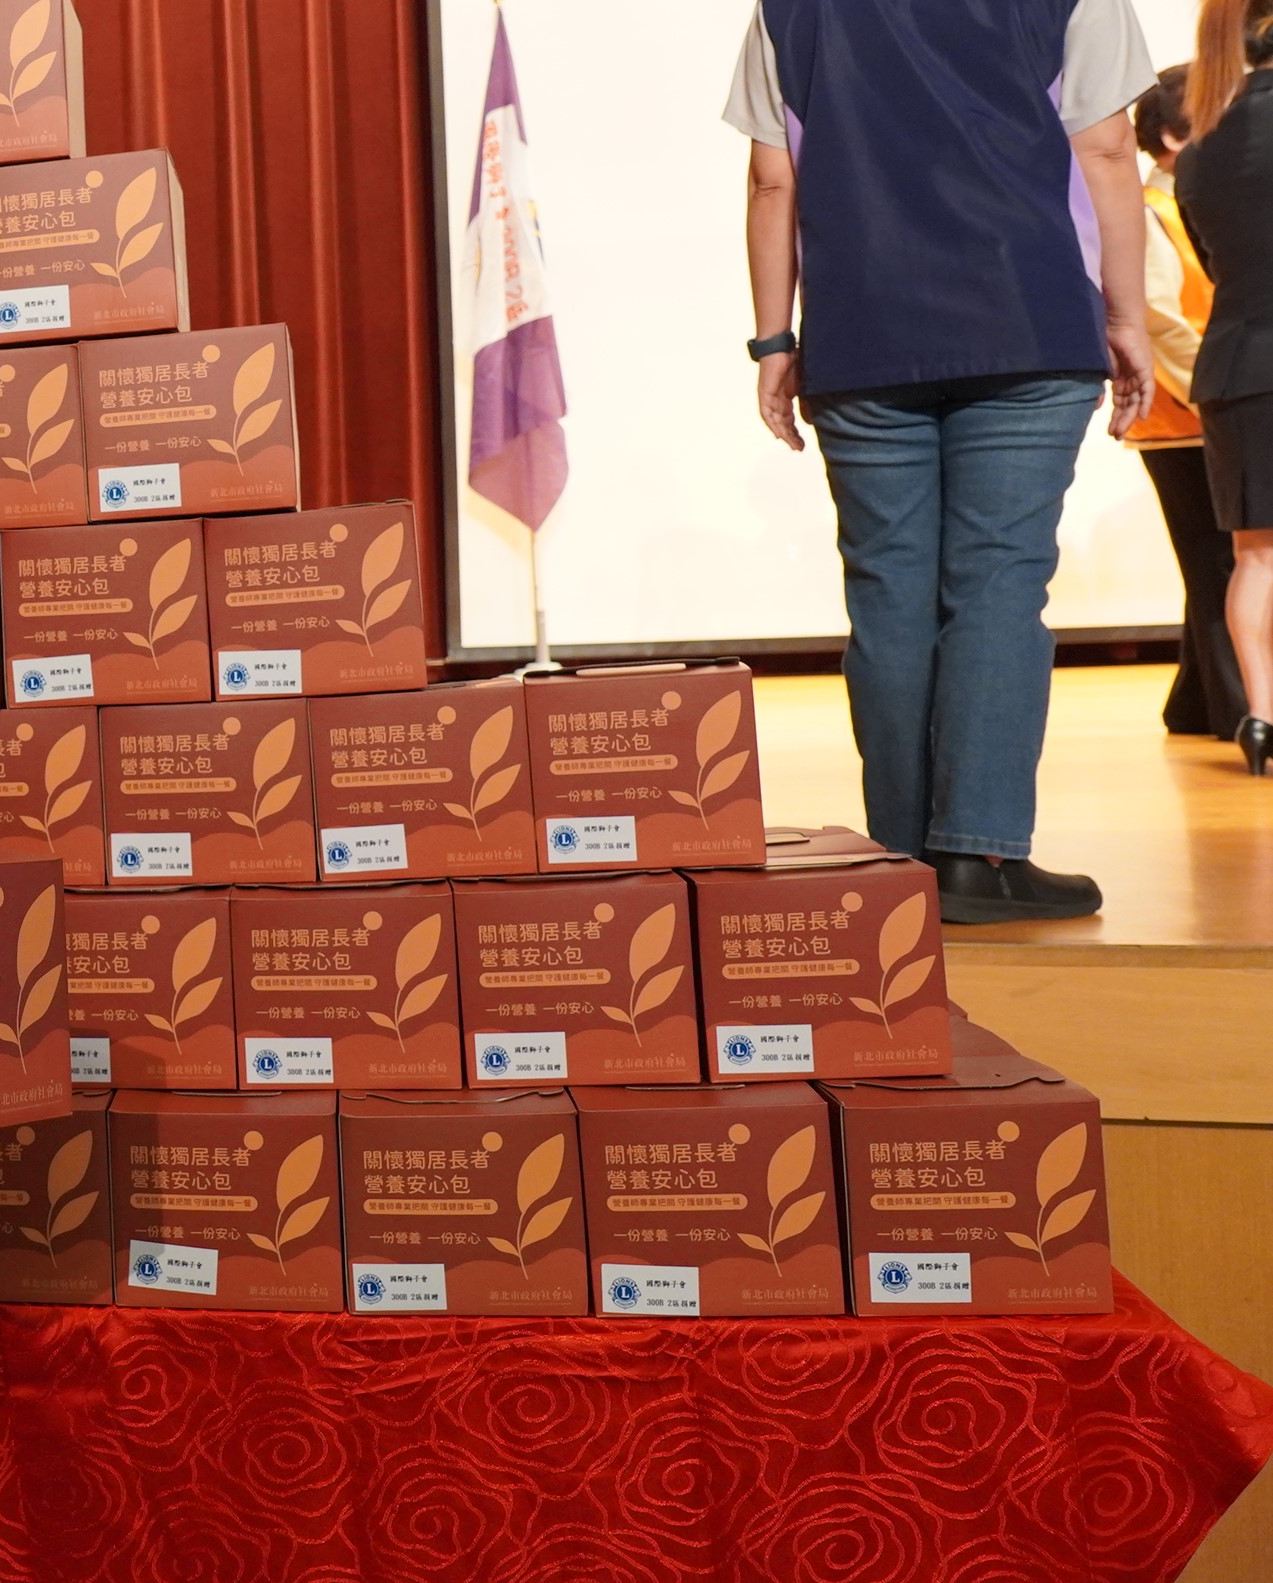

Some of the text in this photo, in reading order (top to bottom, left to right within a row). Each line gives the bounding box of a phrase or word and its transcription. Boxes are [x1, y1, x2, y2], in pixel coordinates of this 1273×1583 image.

[41, 260, 86, 275] 一份安心
[99, 360, 209, 387] 關懷獨居長者
[100, 384, 192, 409] 營養安心包
[104, 436, 202, 453] 一份營養 一份安心
[224, 540, 336, 566] 關懷獨居長者
[19, 554, 126, 577] 關懷獨居長者
[226, 564, 320, 588] 營養安心包
[20, 577, 109, 598] 營養安心包
[231, 616, 330, 633] 一份營養 一份安心
[23, 628, 118, 642] 一份營養 一份安心
[549, 708, 669, 733] 關懷獨居長者
[120, 733, 229, 754] 關懷獨居長者
[330, 722, 444, 746] 關懷獨居長者
[550, 732, 651, 755] 營養安心包
[121, 756, 212, 775] 營養安心包
[332, 746, 427, 768] 營養安心包
[555, 787, 662, 802] 一份營養 一份安心
[125, 808, 222, 820] 一份營養 一份安心
[336, 799, 438, 814] 一份營養 一份安心
[721, 909, 850, 934] 關懷獨居長者
[66, 932, 148, 951] 獨居長者
[251, 928, 370, 948] 關懷獨居長者
[478, 920, 602, 944] 關懷獨居長者
[480, 945, 583, 967] 營養安心包
[723, 935, 831, 959] 營養安心包
[252, 952, 351, 971] 營養安心包
[485, 1002, 595, 1016] 一份營養 一份安心
[728, 993, 843, 1008] 一份營養 一份安心
[91, 1009, 139, 1021] 一份安心
[255, 1007, 361, 1019] 一份營養 一份安心
[130, 1146, 250, 1166] 關懷獨居長者
[363, 1150, 490, 1170] 關懷獨居長者
[605, 1142, 737, 1165] 關懷獨居長者
[870, 1140, 1006, 1163] 關懷獨居長者
[131, 1169, 231, 1190] 營養安心包
[365, 1174, 470, 1194] 營養安心包
[607, 1168, 718, 1190] 營養安心包
[872, 1166, 986, 1188] 營養安心包
[134, 1225, 241, 1240] 一份營養 一份安心
[369, 1231, 481, 1244] 一份營養 一份安心
[614, 1228, 731, 1242] 一份營養 一份安心
[877, 1227, 998, 1241] 一份營養 一份安心
